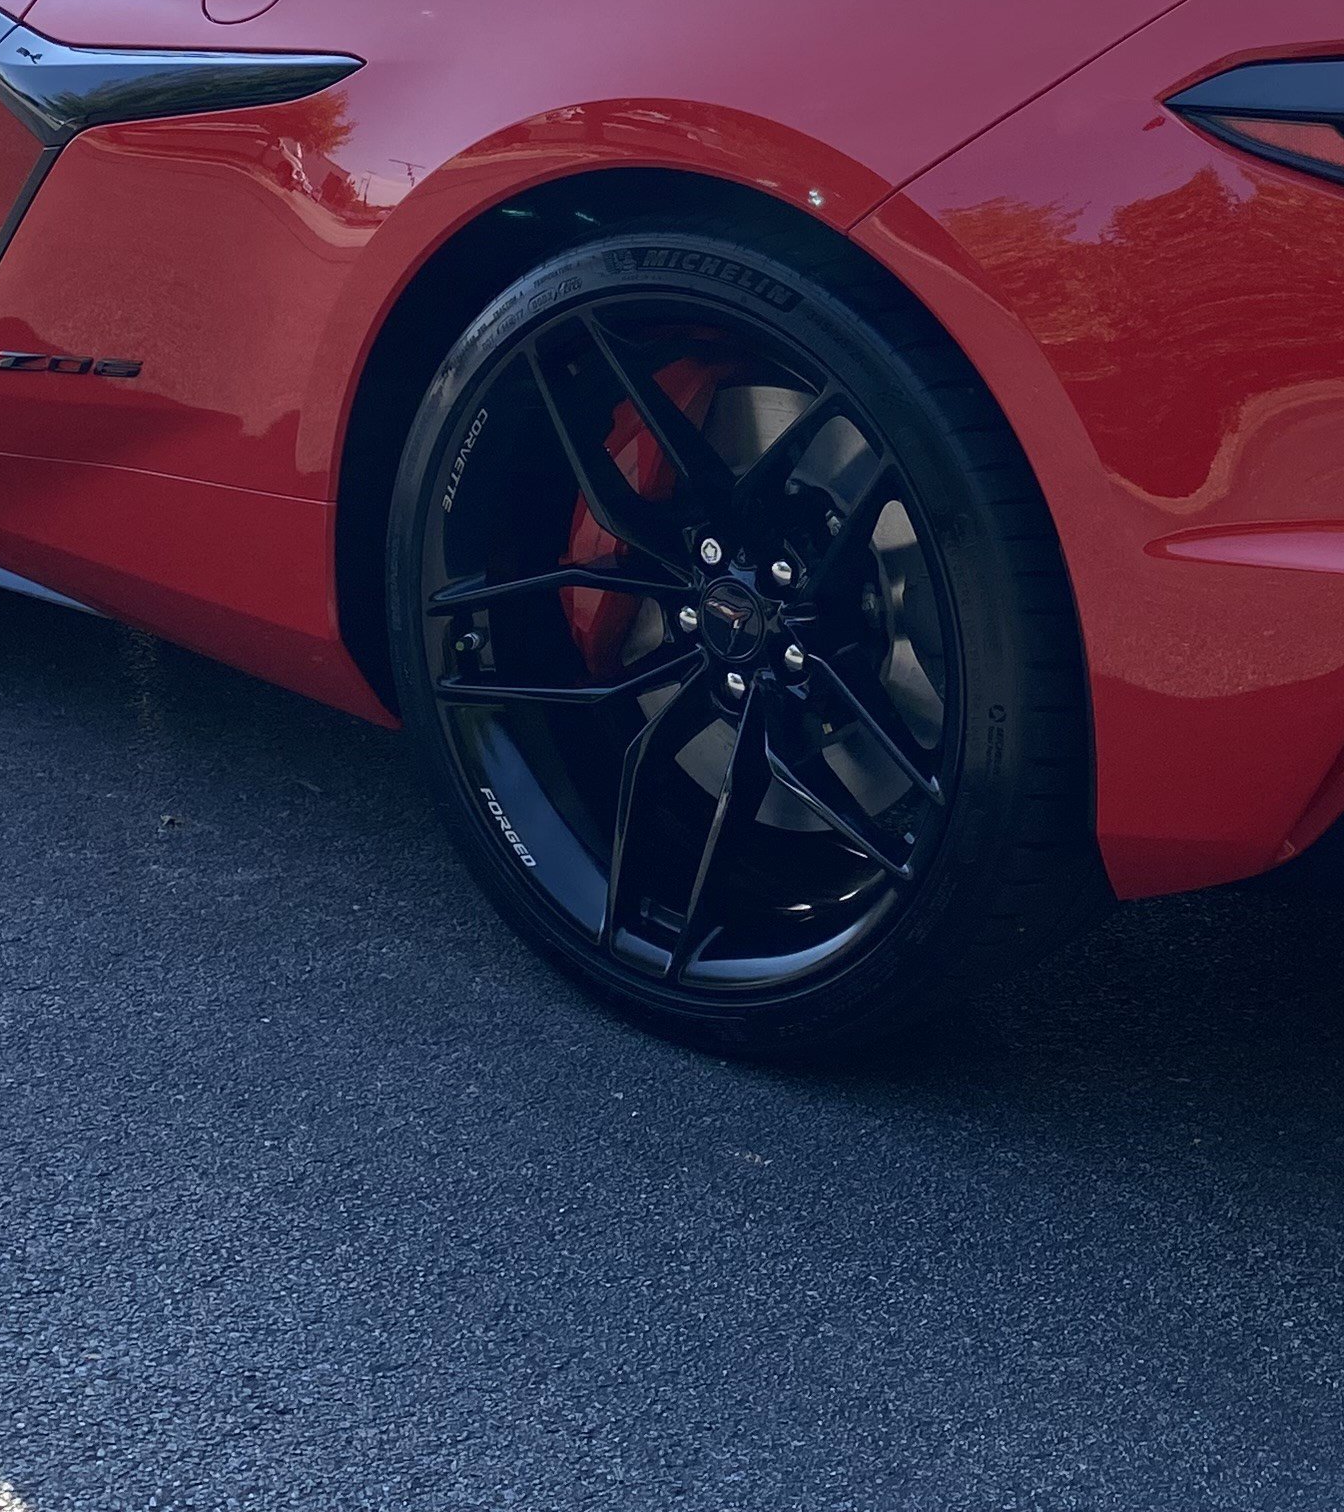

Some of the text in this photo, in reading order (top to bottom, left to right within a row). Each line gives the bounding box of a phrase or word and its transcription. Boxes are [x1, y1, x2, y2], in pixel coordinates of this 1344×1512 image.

[642, 248, 794, 307] MICHELIN
[442, 408, 488, 513] CORVETTE
[480, 788, 536, 867] FORGED
